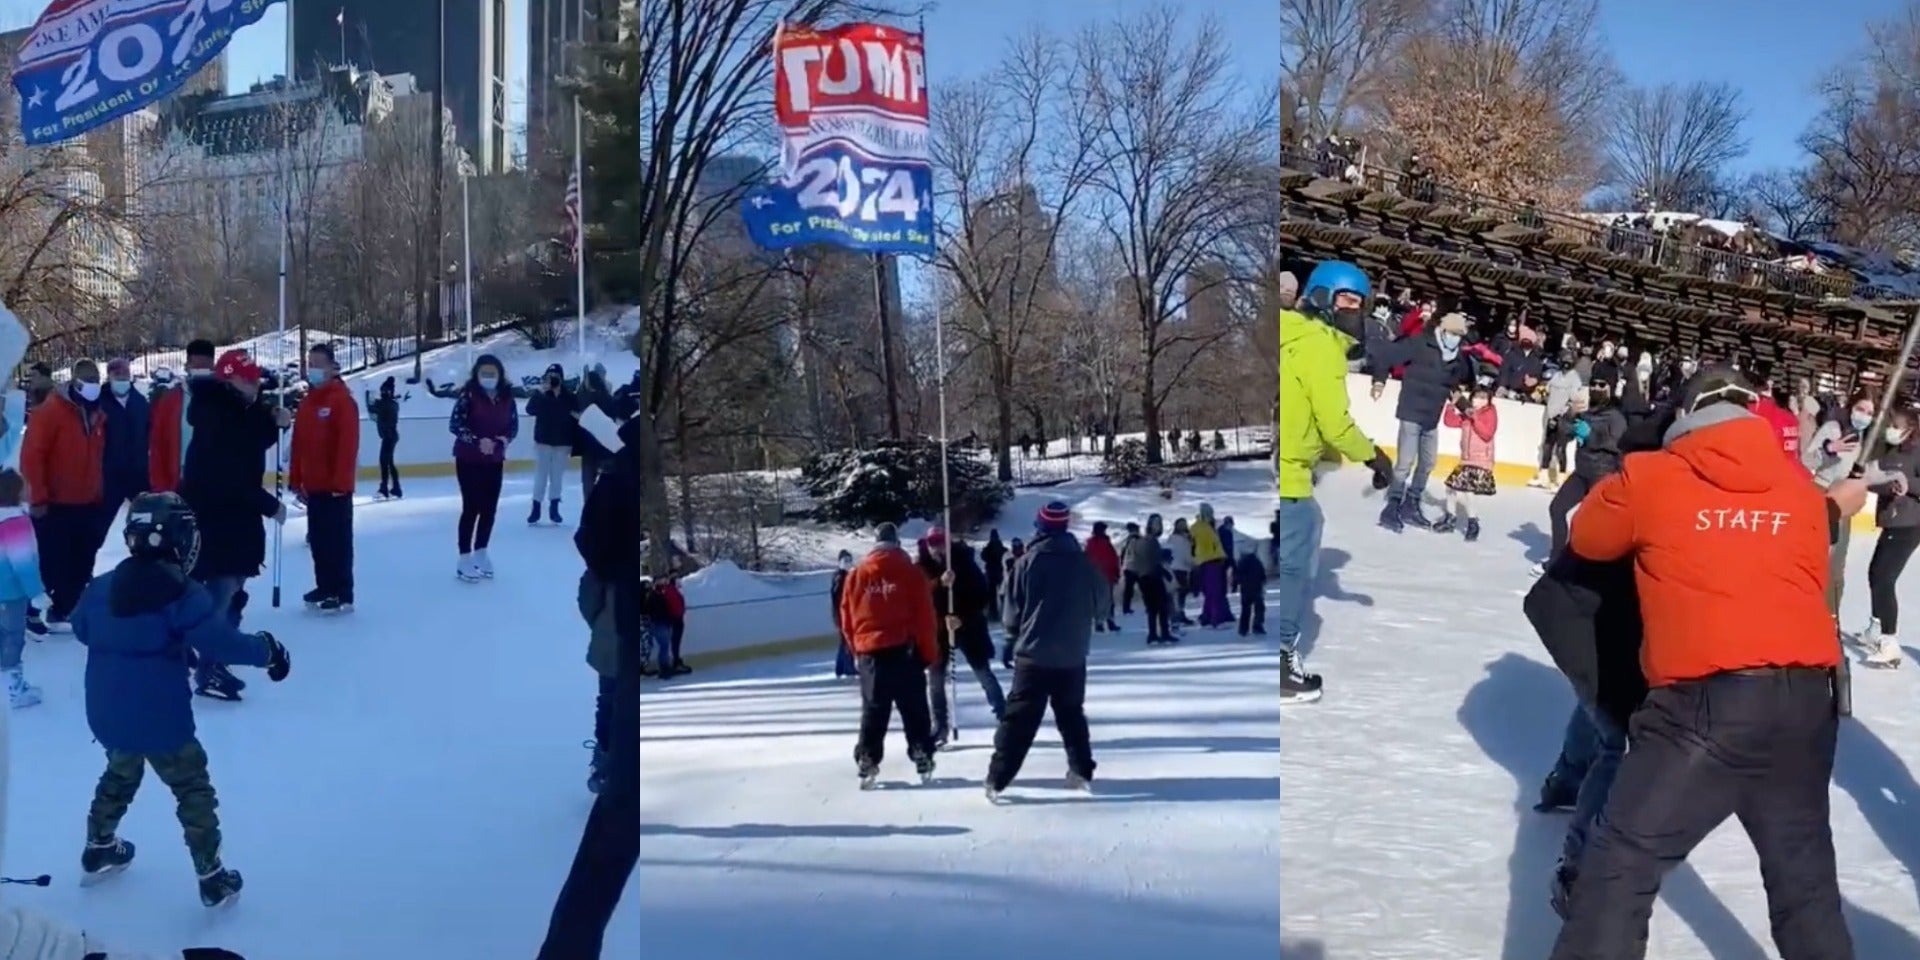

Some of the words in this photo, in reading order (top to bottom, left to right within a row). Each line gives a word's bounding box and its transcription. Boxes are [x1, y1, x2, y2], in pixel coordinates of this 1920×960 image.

[33, 124, 58, 139] For
[62, 91, 134, 126] President
[770, 221, 801, 236] For
[1695, 508, 1790, 535] STAFF
